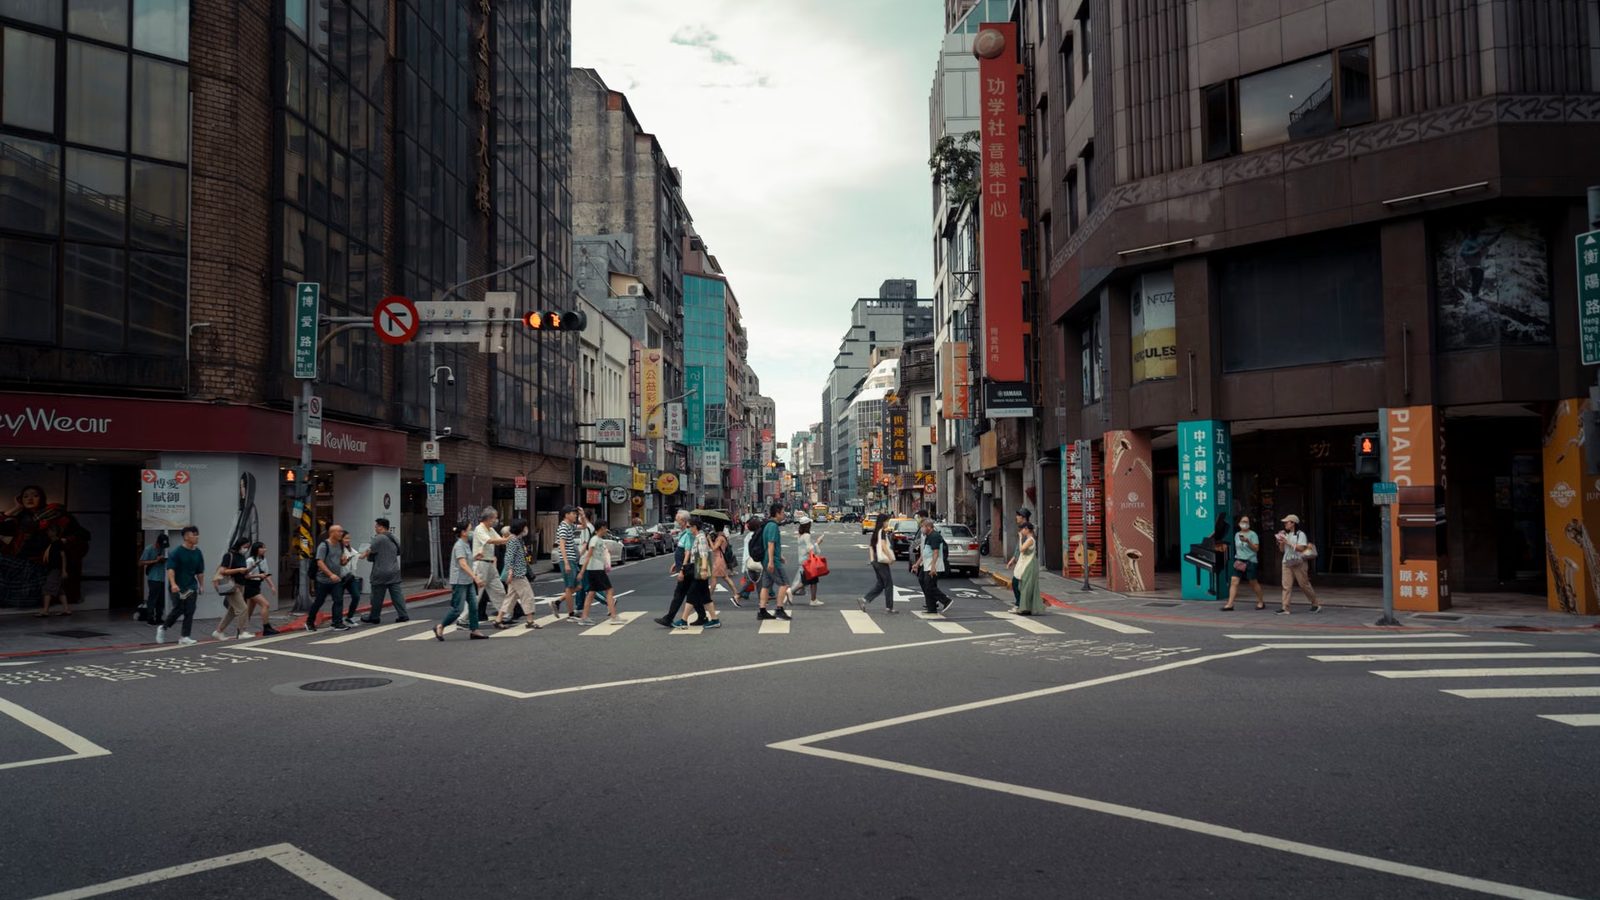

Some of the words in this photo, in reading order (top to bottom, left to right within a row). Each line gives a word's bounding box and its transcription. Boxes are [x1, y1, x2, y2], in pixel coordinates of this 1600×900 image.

[987, 78, 1006, 218] 功学社音樂中心
[1583, 248, 1600, 315] 衡陽路
[301, 295, 314, 348] 博愛路
[0, 407, 112, 437] yWear
[1192, 430, 1206, 519] 中古鋼琴中心
[1085, 486, 1095, 526] 招生中
[1399, 569, 1428, 583] 原木
[1399, 585, 1429, 598] 鋼琴
